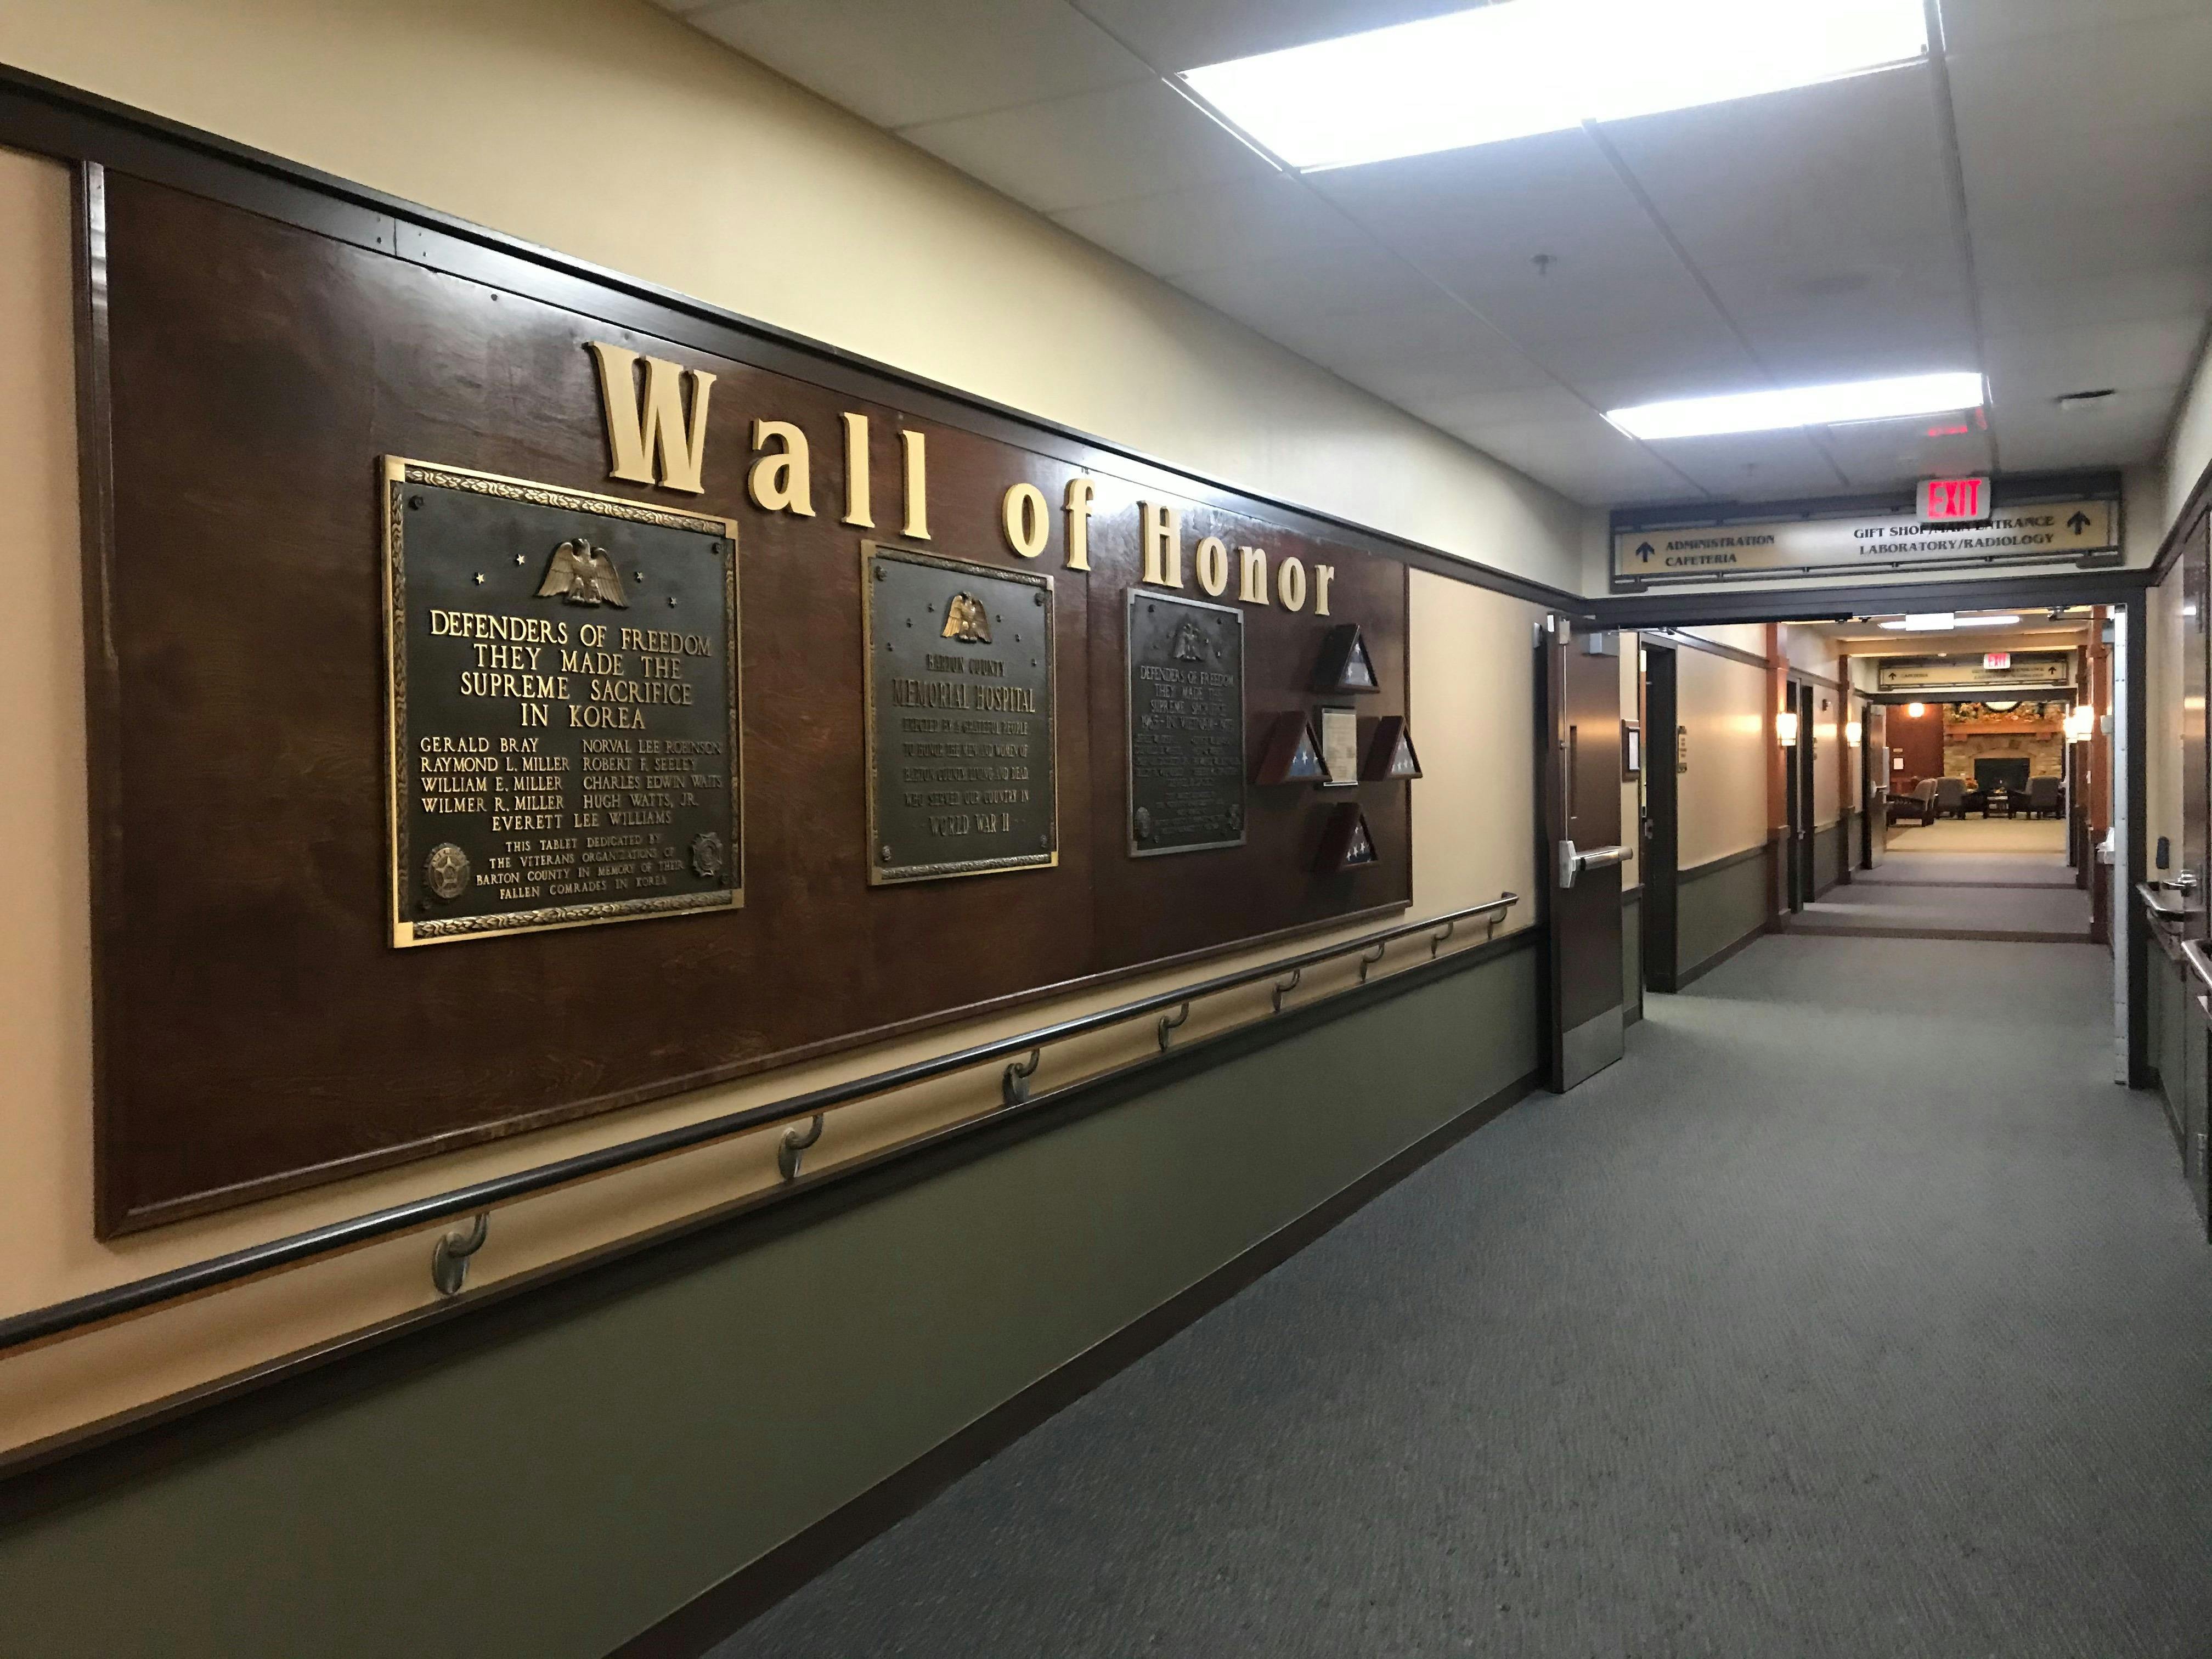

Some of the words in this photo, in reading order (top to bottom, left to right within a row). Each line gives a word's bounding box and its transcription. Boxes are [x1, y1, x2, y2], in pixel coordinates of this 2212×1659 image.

[583, 341, 932, 540] Wall
[1003, 478, 1096, 572] of
[1137, 500, 1334, 616] Honor
[1928, 479, 1982, 520] EXIT
[1666, 534, 1775, 551] ADMINISTRATION
[1854, 527, 1883, 539] GIFT
[1859, 533, 2054, 556] LABORATORY/RADIOLOGY
[1666, 553, 1737, 567] CAFETERIA
[430, 609, 568, 645] DEFENDERS
[579, 623, 607, 647] OF
[620, 628, 712, 657] FREEDOM
[473, 643, 541, 670] THEY
[560, 649, 625, 676] MADE
[641, 656, 681, 679] THE
[460, 671, 570, 700] SUPREME
[590, 679, 693, 705] SACRIFICE
[893, 678, 969, 709] MEMORIAL
[975, 684, 1036, 713] HOSPITAL
[521, 703, 549, 727] IN
[569, 704, 646, 730] KOREA
[420, 737, 489, 753] GERALD
[500, 737, 539, 753] BRAY
[582, 739, 631, 754] NORVAL
[638, 740, 660, 754] LEE
[420, 757, 498, 772] RAYMOND
[505, 757, 518, 772] L.
[522, 757, 571, 772] MILLER
[582, 757, 633, 771] ROBERT
[421, 776, 488, 793] WILLIAM
[495, 776, 509, 792] E.
[514, 776, 563, 791] MILLER
[583, 775, 641, 791] CHARLES
[646, 775, 685, 789] EDWIN
[421, 797, 488, 814] WILMER
[494, 797, 510, 812] R.
[514, 795, 565, 811] MILLER
[583, 794, 621, 809] HUGH
[492, 814, 563, 832] EVERETT
[573, 812, 600, 828] LEE
[608, 810, 672, 826] WILLIAMS
[974, 812, 997, 833] WAR
[1001, 812, 1009, 832] II
[505, 840, 532, 853] THIS
[539, 838, 578, 851] TABLET
[586, 834, 642, 848] DEDICATED
[489, 856, 512, 869] THE
[520, 853, 575, 867] VETERANS
[476, 872, 520, 887] BARTON
[527, 868, 571, 882] COUNTY
[578, 867, 590, 878] IN
[597, 864, 635, 877] MEMORY
[640, 861, 653, 873] OF
[658, 859, 685, 871] THEIR
[500, 885, 540, 900] FALLEN
[549, 879, 607, 895] COMRADES
[615, 878, 629, 889] IN
[636, 876, 667, 888] KOREA
